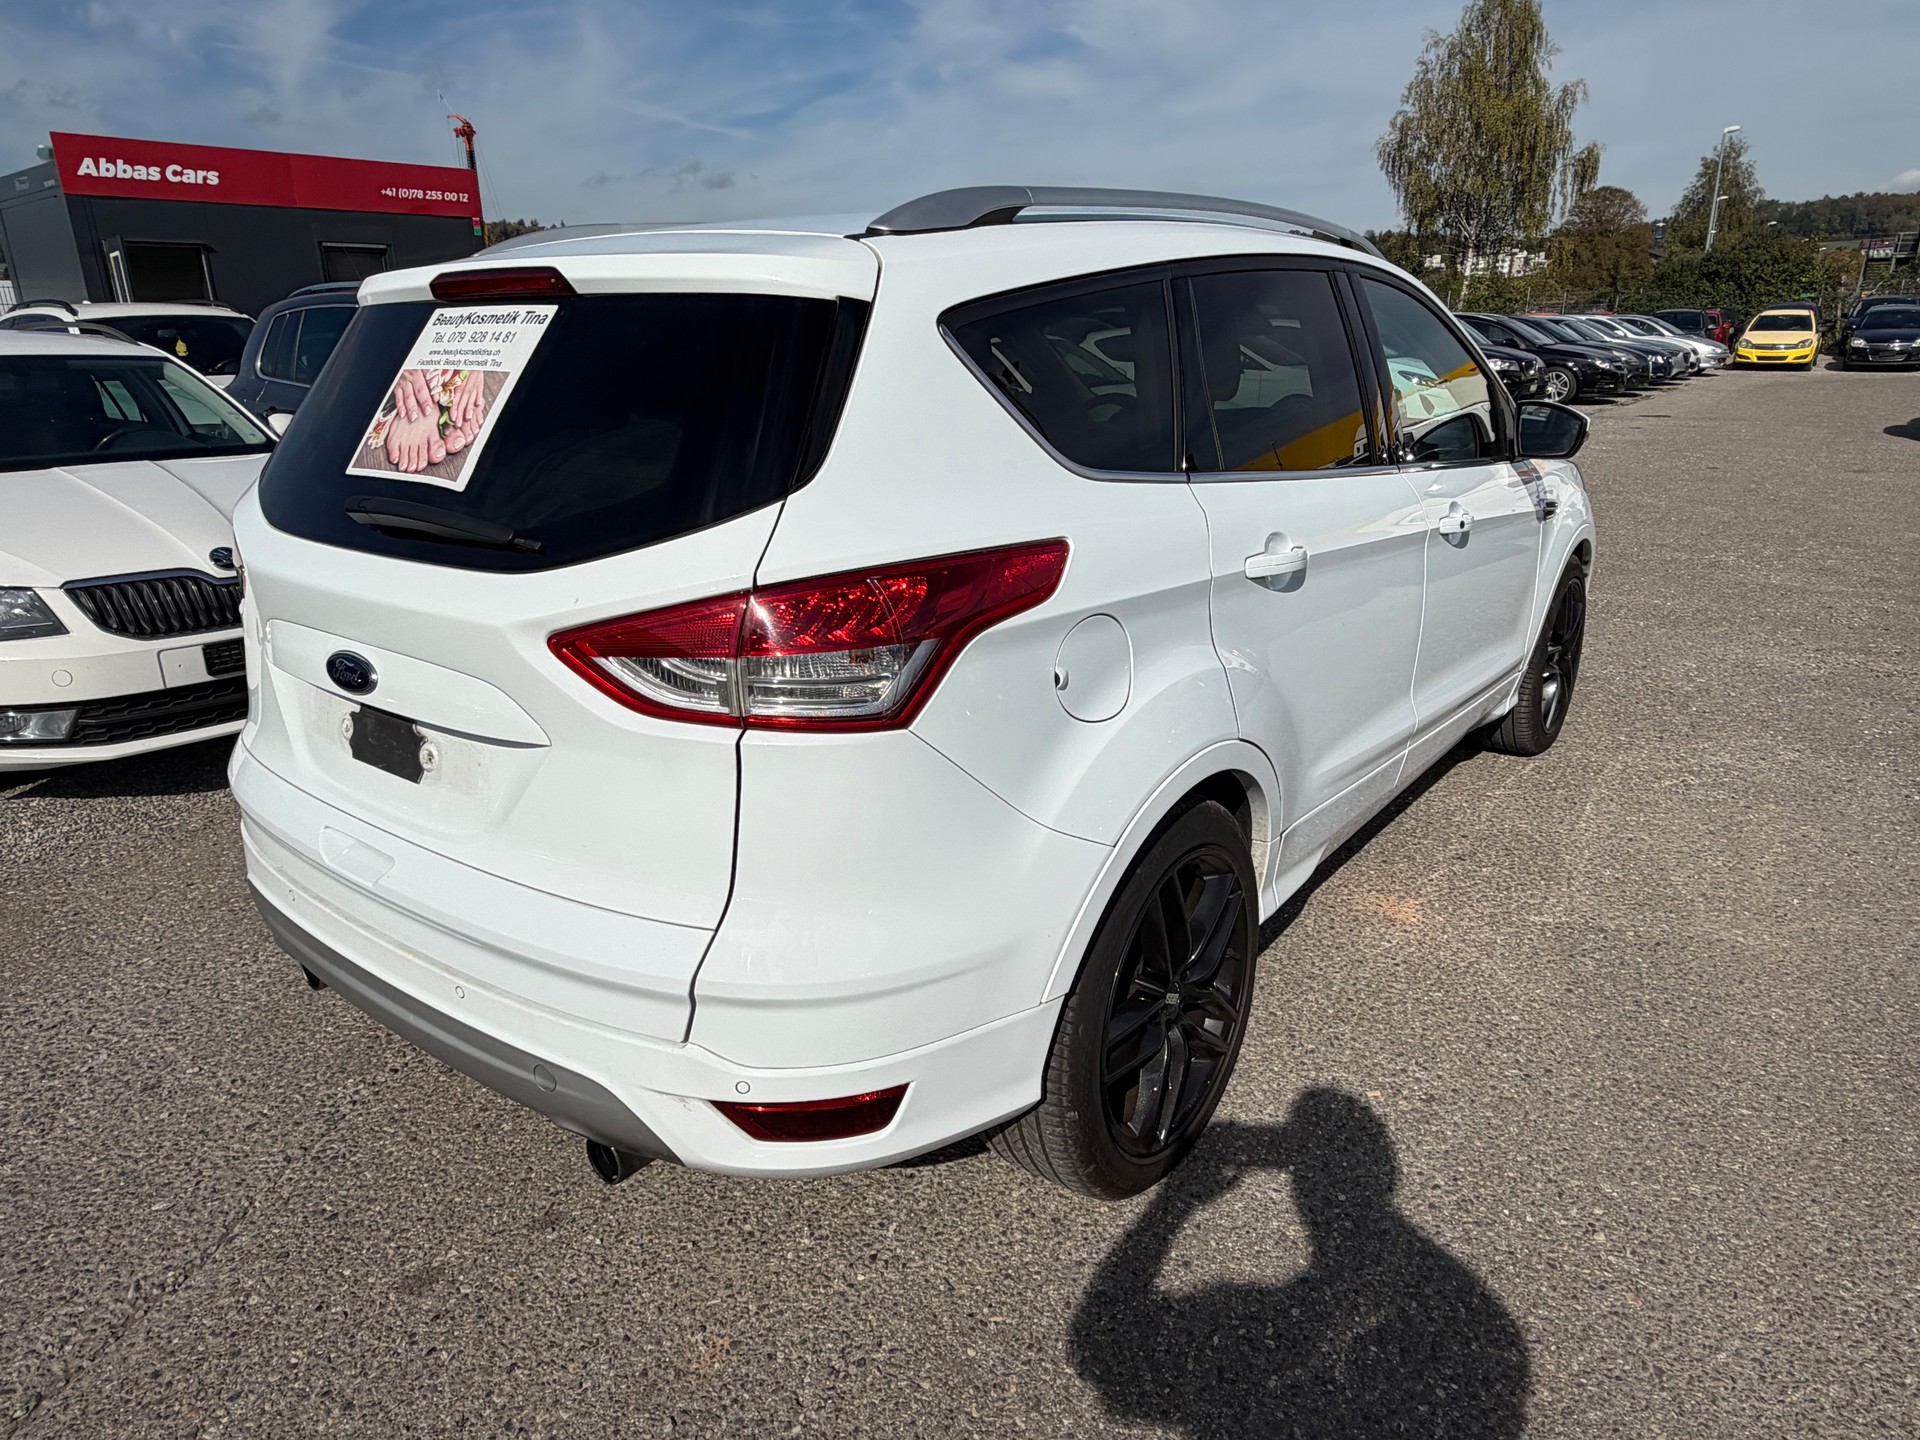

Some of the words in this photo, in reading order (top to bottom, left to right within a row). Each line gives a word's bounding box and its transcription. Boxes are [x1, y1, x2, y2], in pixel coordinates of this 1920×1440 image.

[77, 157, 161, 181] Abbas
[165, 164, 220, 186] Cars
[380, 187, 396, 197] +41
[398, 187, 424, 200] (0)78
[425, 190, 443, 201] 255
[444, 191, 458, 202] 00
[459, 193, 469, 203] 12
[432, 311, 521, 328] BeautyKosmetik
[520, 311, 549, 325] Tina
[432, 332, 445, 343] Tel.
[447, 331, 467, 343] 079
[468, 331, 489, 343] 928
[489, 331, 503, 343] 14
[502, 331, 518, 343] 81
[463, 358, 489, 368] Kosmetik
[490, 359, 503, 367] Tina
[332, 658, 361, 685] Ford
